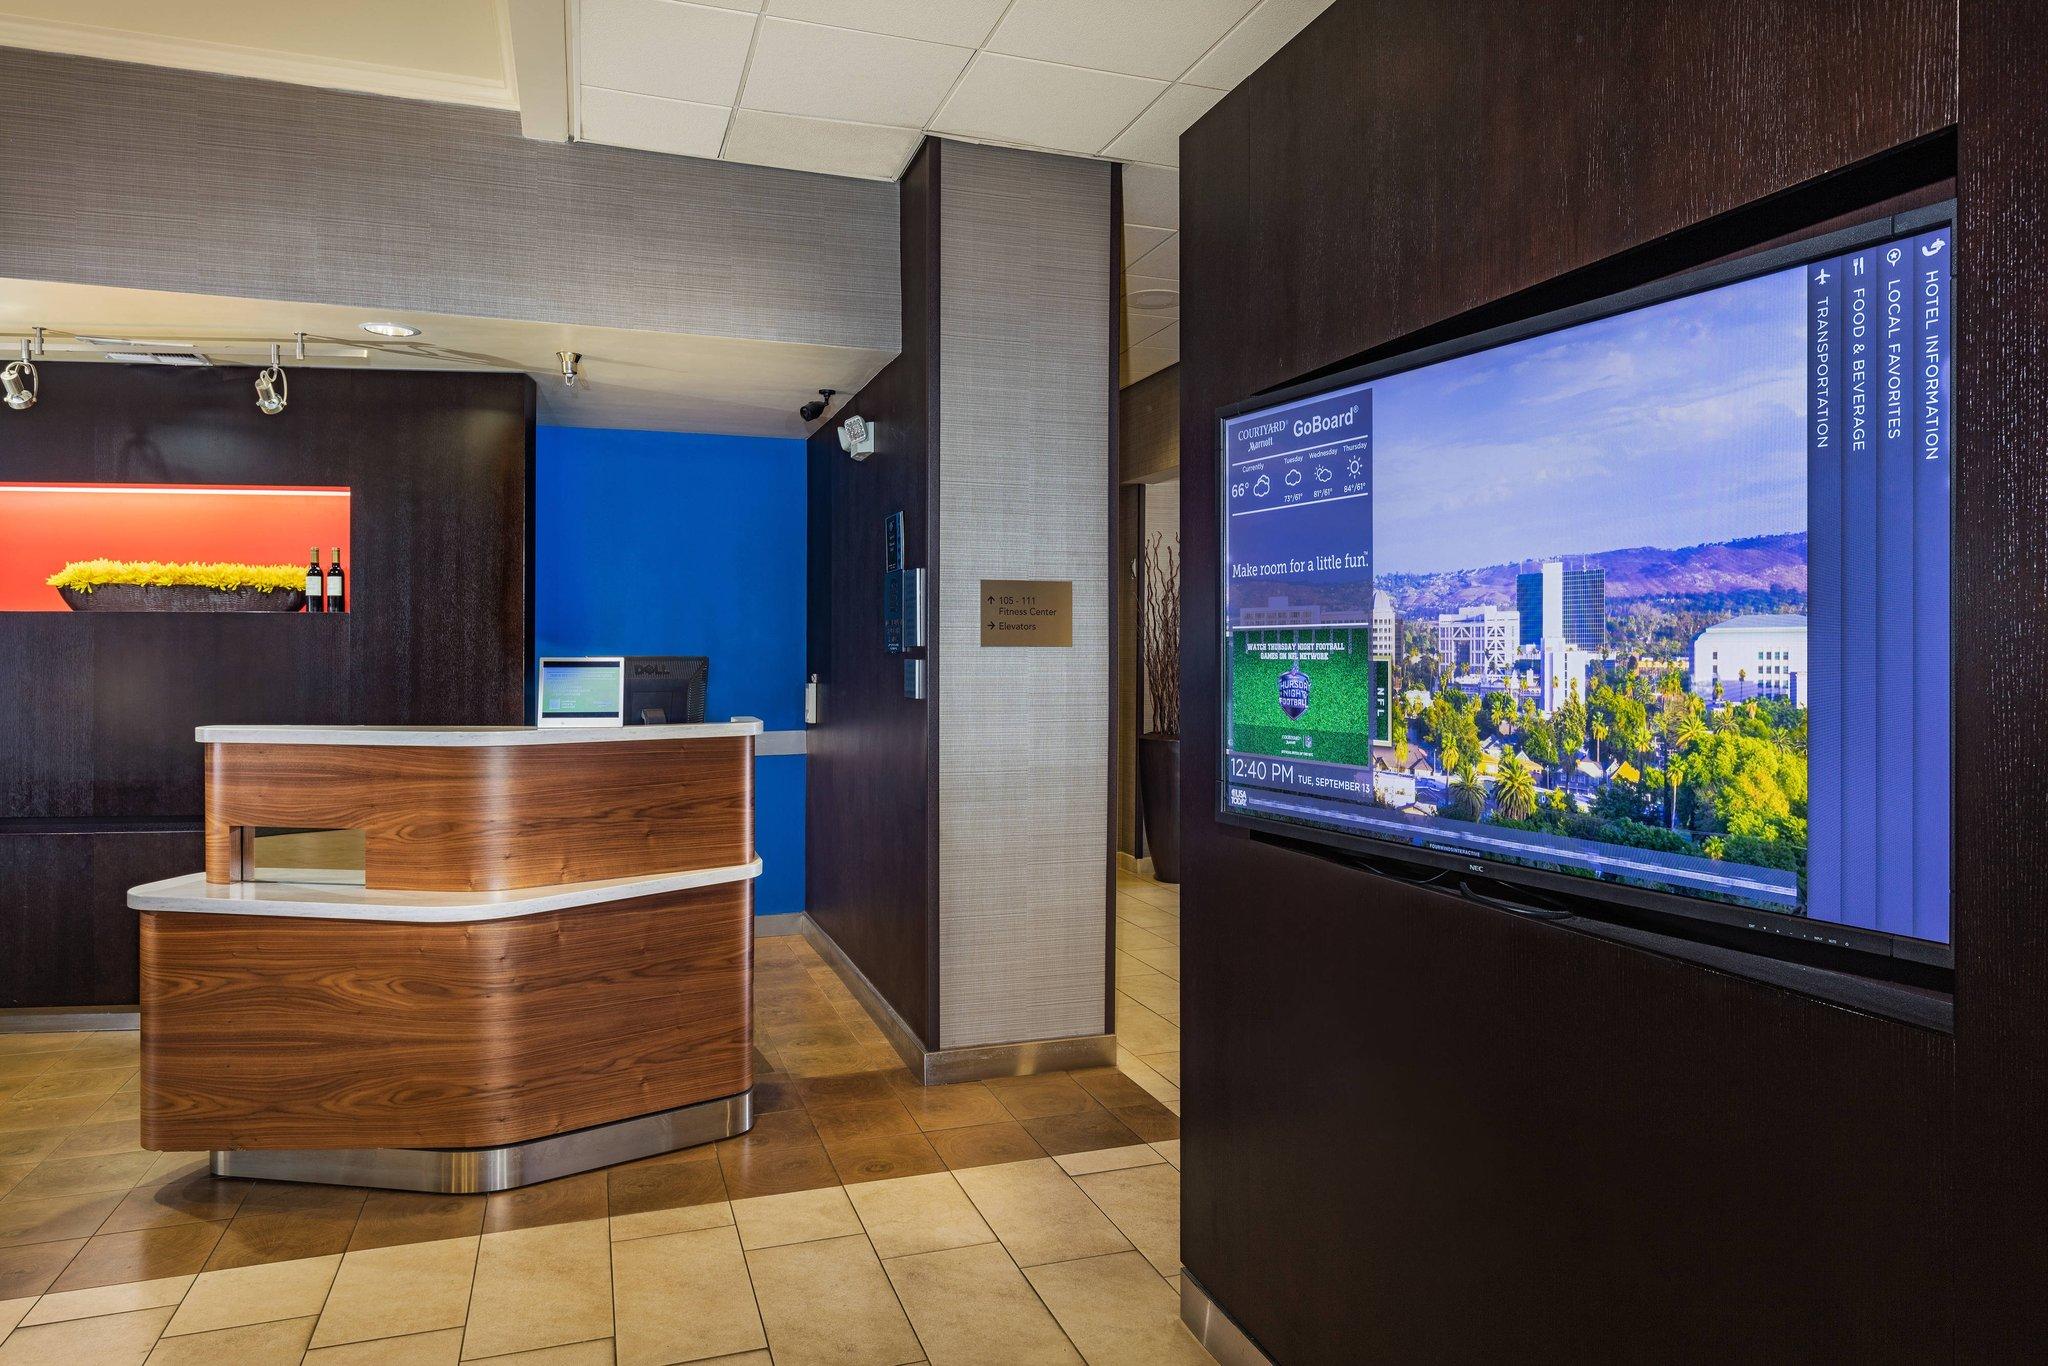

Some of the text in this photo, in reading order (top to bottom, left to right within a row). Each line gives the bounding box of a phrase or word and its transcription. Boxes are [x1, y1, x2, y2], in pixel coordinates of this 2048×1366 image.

[1888, 279, 1901, 439] LOCAL FAVORITES
[1852, 288, 1865, 452] FOOD & BEVERAGE
[1925, 270, 1939, 460] HOTEL INFORMATION
[1816, 296, 1829, 448] TRANSPORTATION
[1343, 441, 1367, 452] Thursday
[1309, 448, 1338, 459] Wednesday
[1284, 456, 1303, 464] Tuesday
[1242, 462, 1264, 473] Currently
[1232, 563, 1258, 578] Make
[1260, 562, 1287, 576] room
[1290, 558, 1305, 573] for
[1307, 560, 1314, 572] a
[1316, 554, 1342, 571] little
[999, 596, 1014, 605] 105
[1022, 596, 1035, 605] 111
[999, 607, 1056, 616] Fitness Center
[999, 622, 1037, 631] Elevators
[1246, 643, 1266, 651] WATCH
[1268, 643, 1296, 651] THURSDAY
[1315, 642, 1345, 651] FOOTBALL
[1299, 652, 1329, 660] NETWORK
[634, 664, 670, 675] DELL
[1377, 687, 1385, 717] NFL
[1231, 758, 1370, 793] 12:40 PM TUE, SEPTEMBER 13
[1469, 864, 1484, 873] NEC
